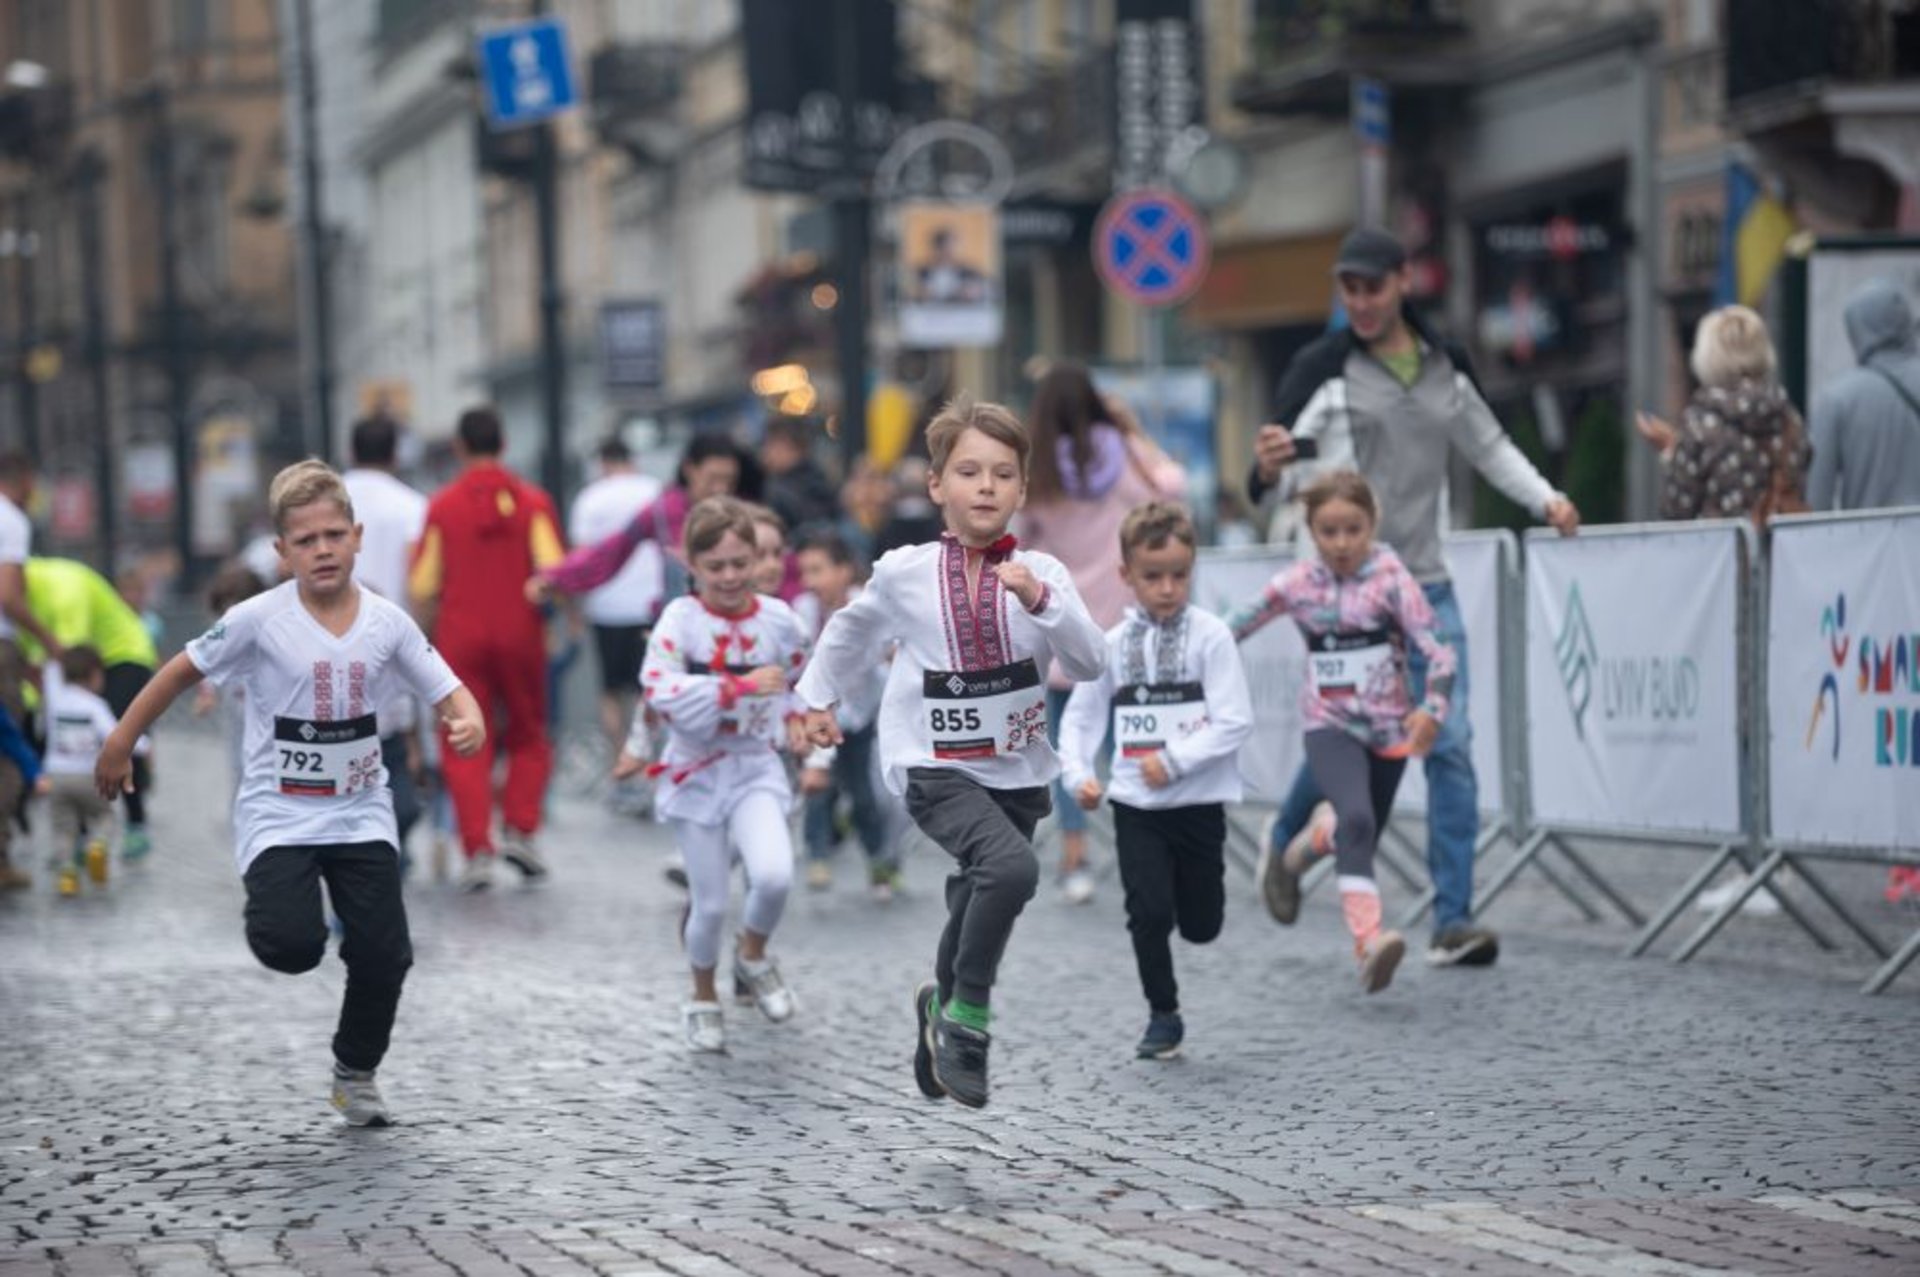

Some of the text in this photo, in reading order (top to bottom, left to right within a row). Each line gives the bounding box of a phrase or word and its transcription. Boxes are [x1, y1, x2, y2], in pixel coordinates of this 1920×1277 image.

[1603, 656, 1699, 720] LVIV BUD
[930, 707, 981, 731] 855
[1121, 714, 1157, 734] 790
[280, 749, 323, 772] 792
